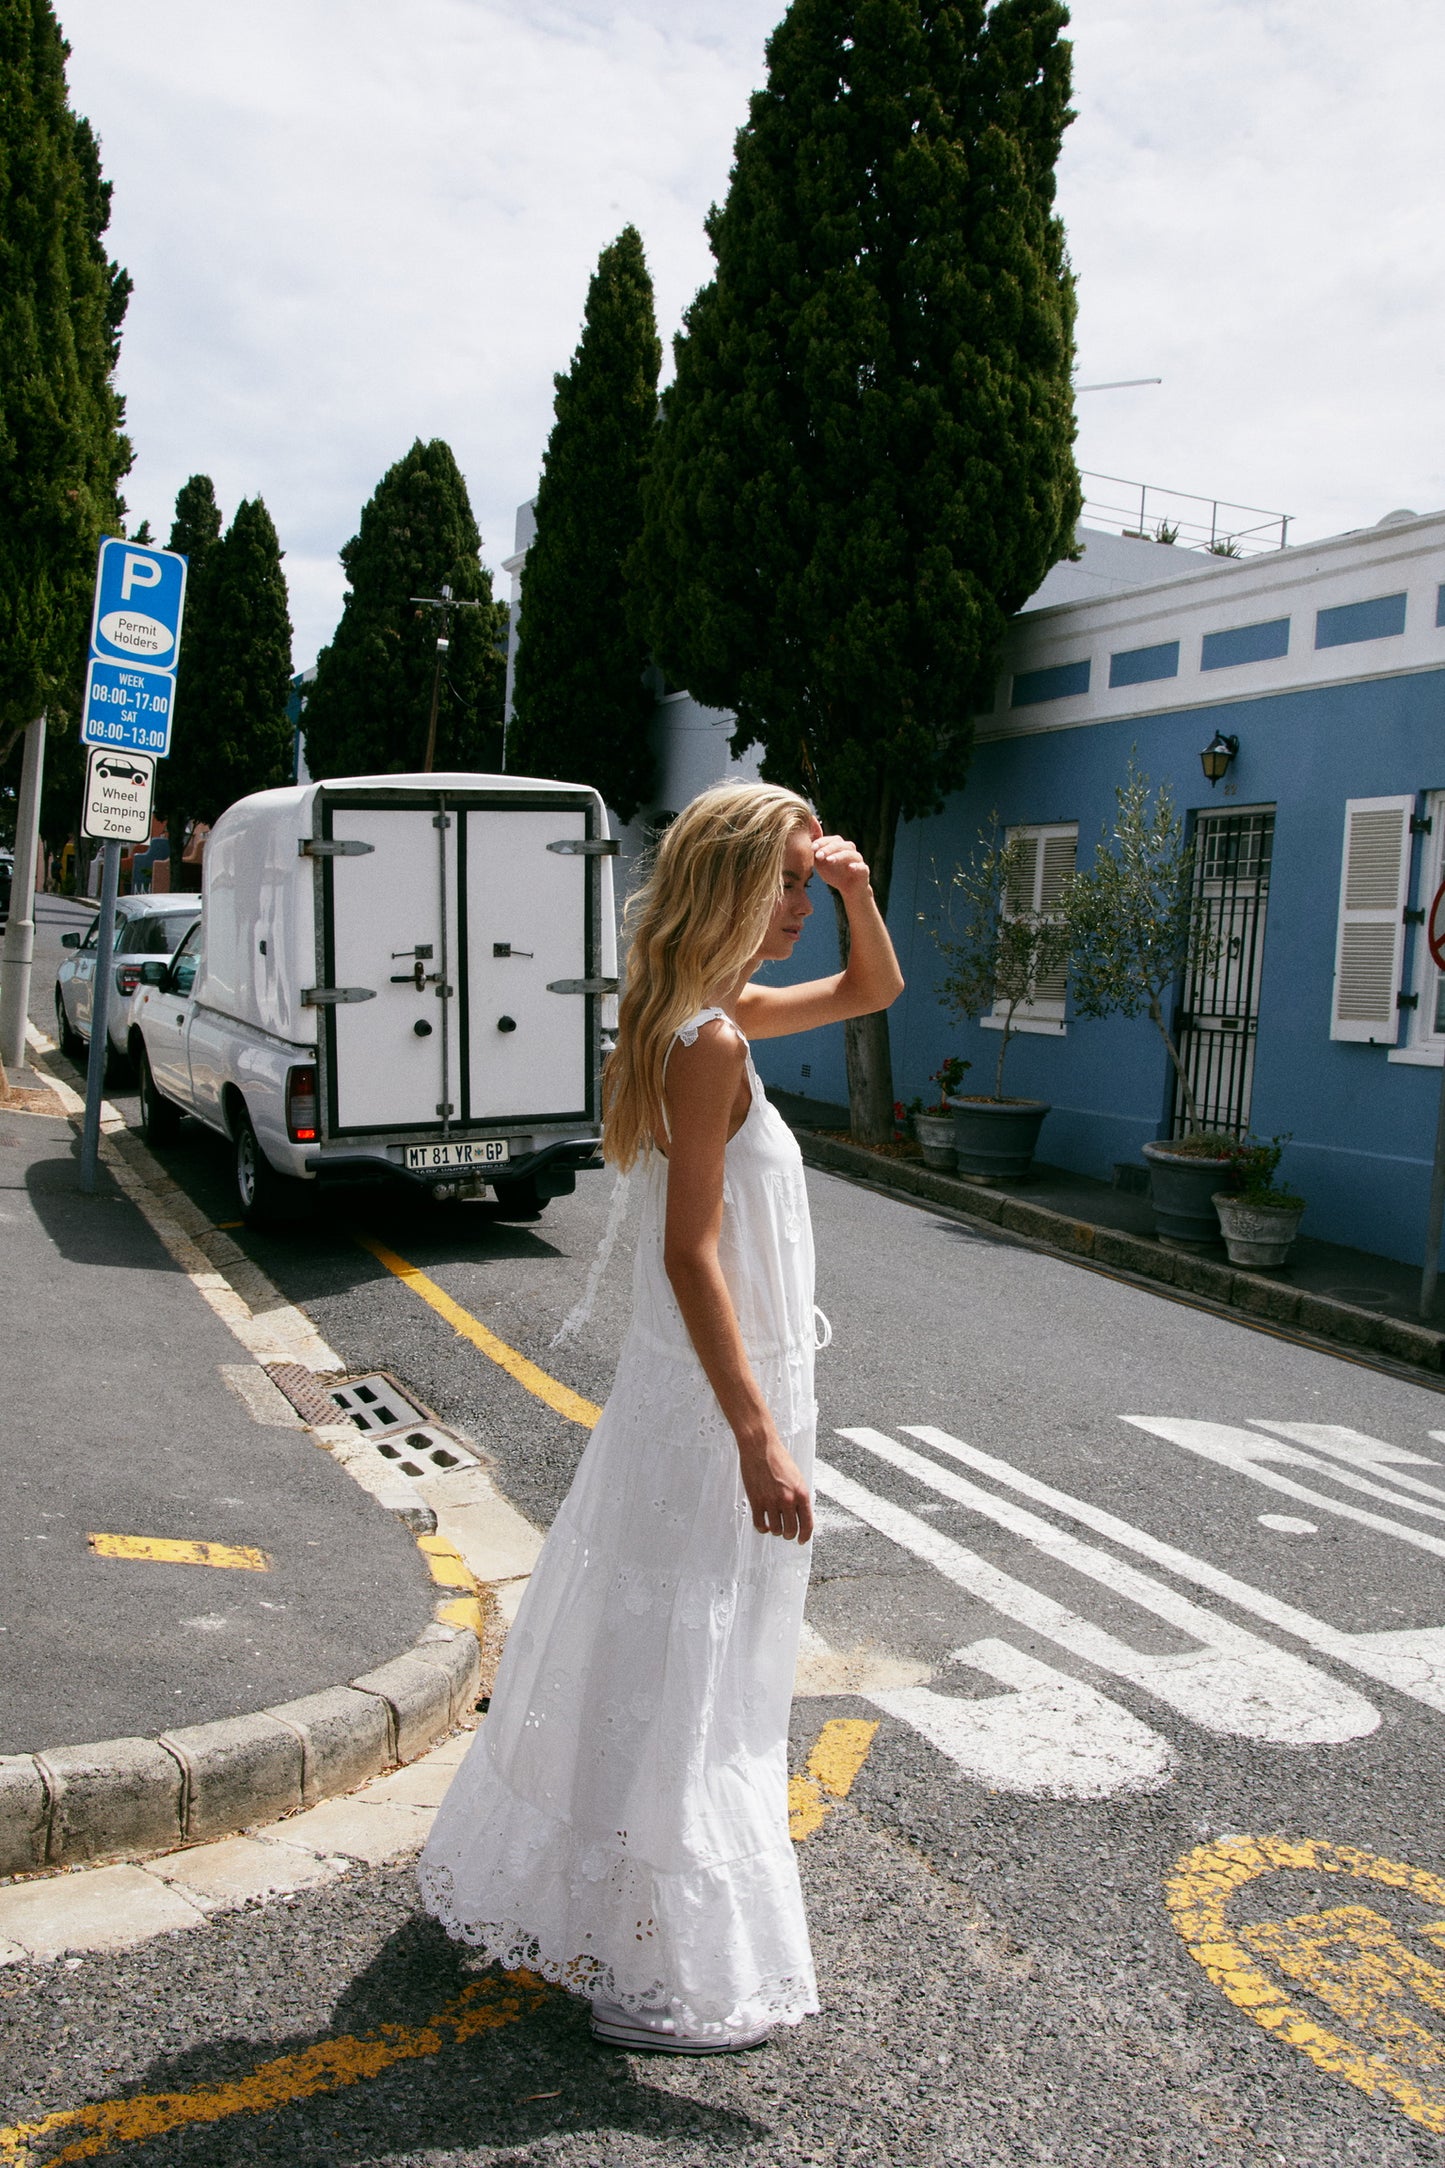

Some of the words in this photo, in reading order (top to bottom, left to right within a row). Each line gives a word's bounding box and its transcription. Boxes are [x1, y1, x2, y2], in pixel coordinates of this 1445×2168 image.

[121, 552, 162, 600] P
[118, 618, 157, 637] Permit
[114, 631, 158, 650] Holders
[119, 673, 145, 689] WEEK
[92, 684, 168, 713] 08:00-17:00
[121, 710, 138, 723] SAT
[89, 719, 165, 748] 08:00-13:00
[102, 786, 138, 802] Wheel
[91, 801, 146, 821] Clamping
[103, 819, 132, 834] Zone
[410, 1149, 427, 1166] MT
[433, 1147, 449, 1164] 81
[455, 1145, 472, 1162] YR
[486, 1143, 502, 1160] GP
